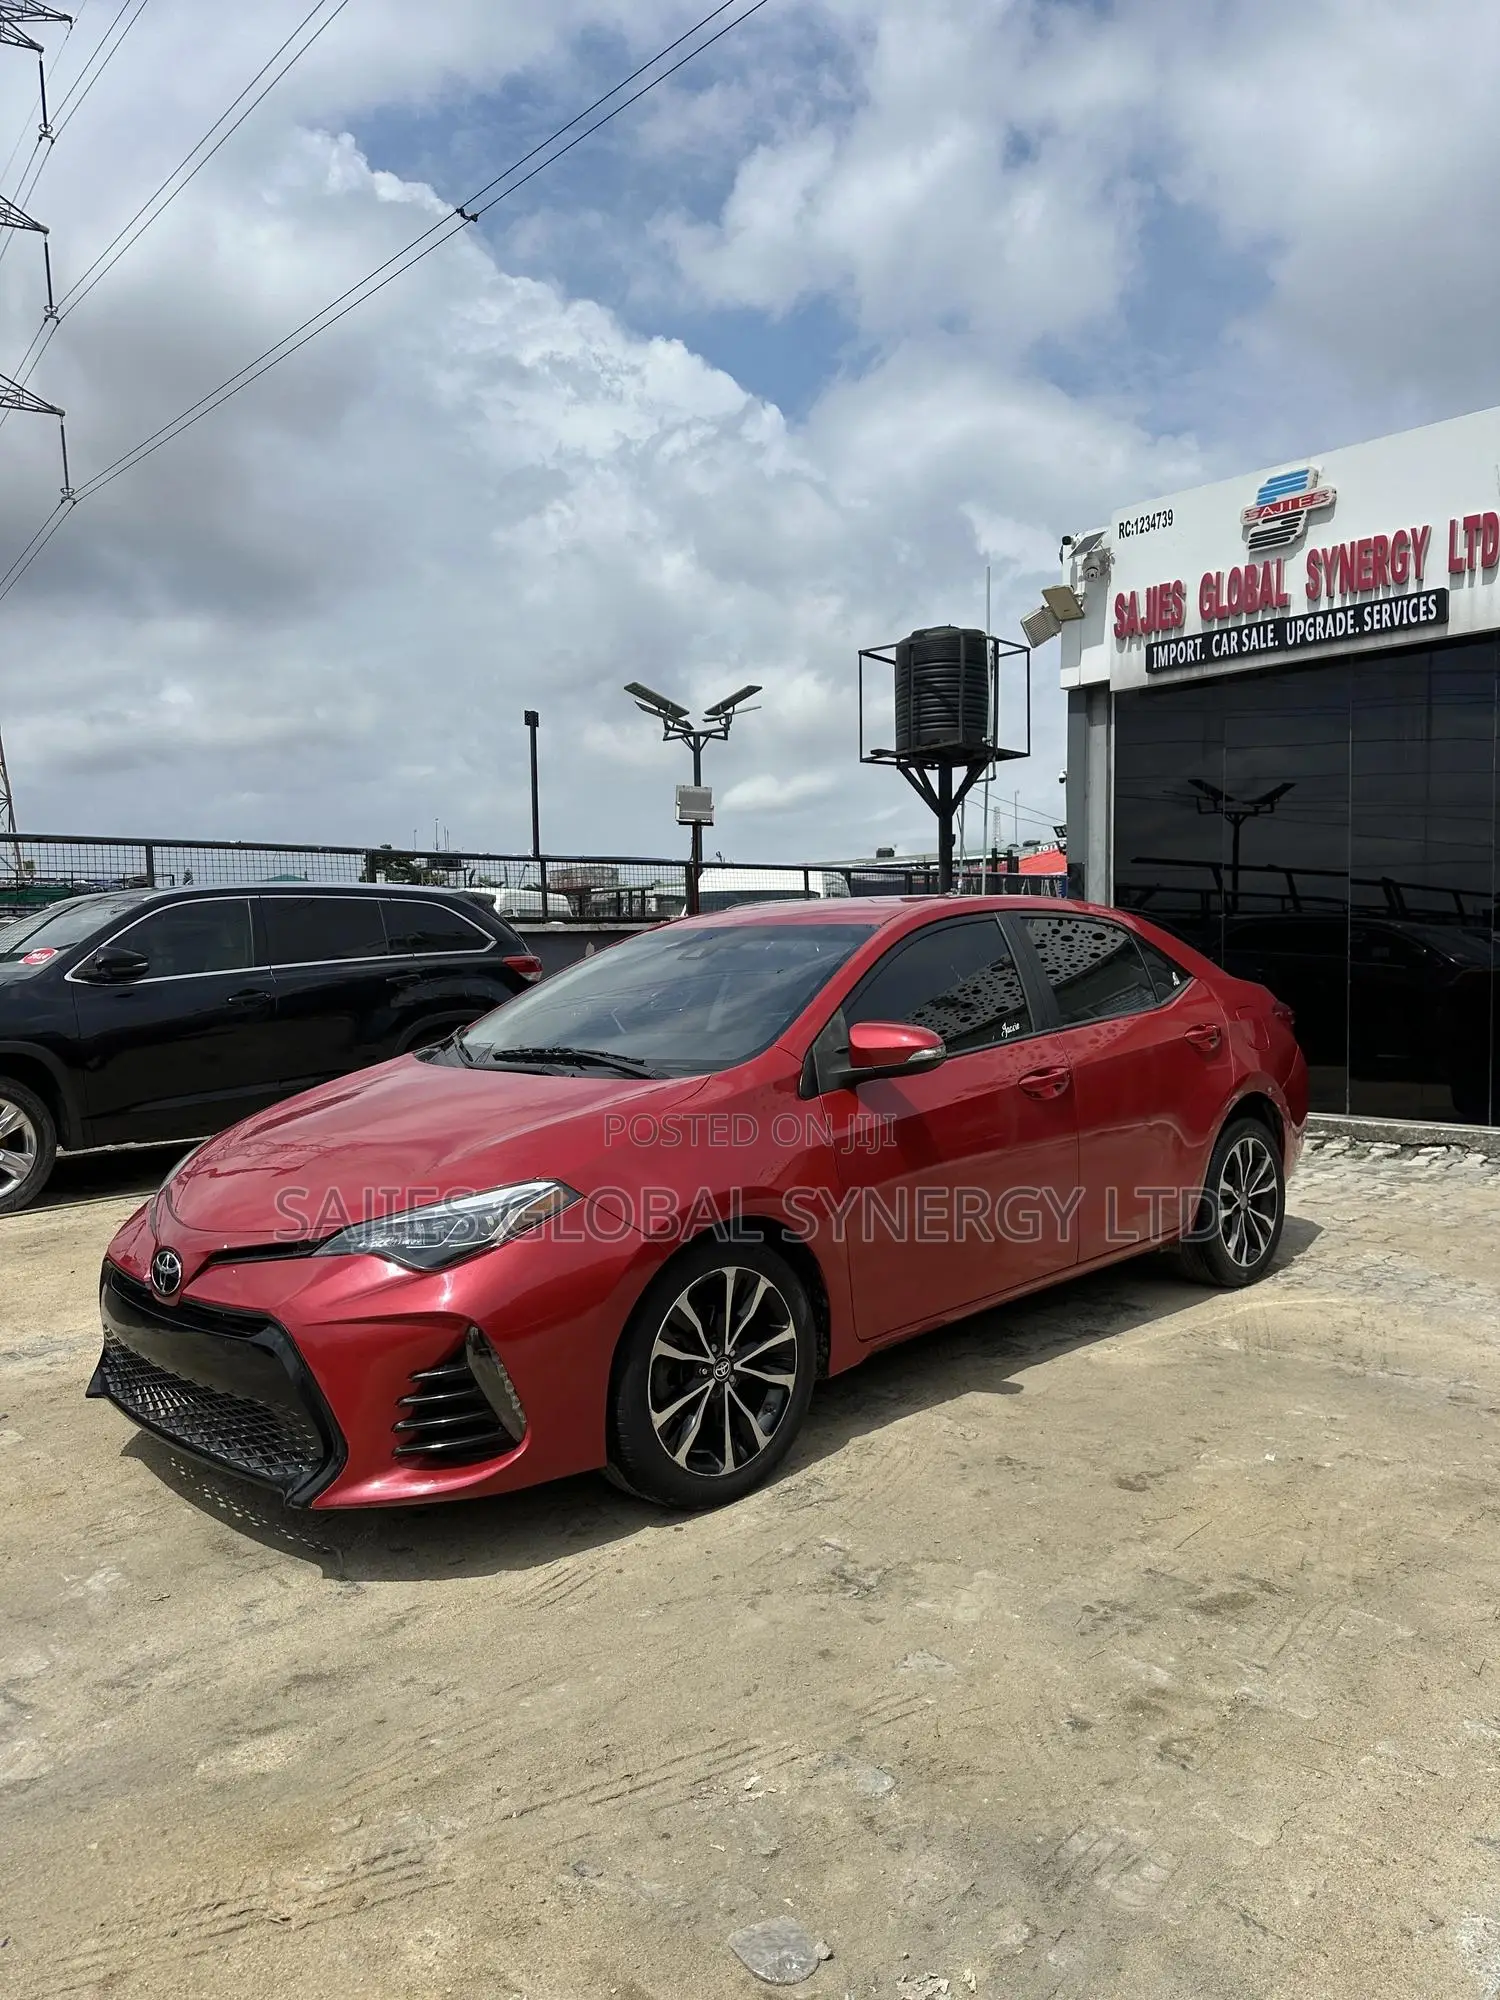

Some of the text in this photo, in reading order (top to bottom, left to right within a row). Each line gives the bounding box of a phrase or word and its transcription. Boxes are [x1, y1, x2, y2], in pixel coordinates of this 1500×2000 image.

[1118, 508, 1174, 539] RC:1234739
[1243, 489, 1330, 521] SAJIES
[1114, 511, 1500, 640] SAJIES GLOBAL SYNERGY LTD
[1152, 594, 1438, 669] IMPORT. CAR SALE. UPGRADE. SERVICES
